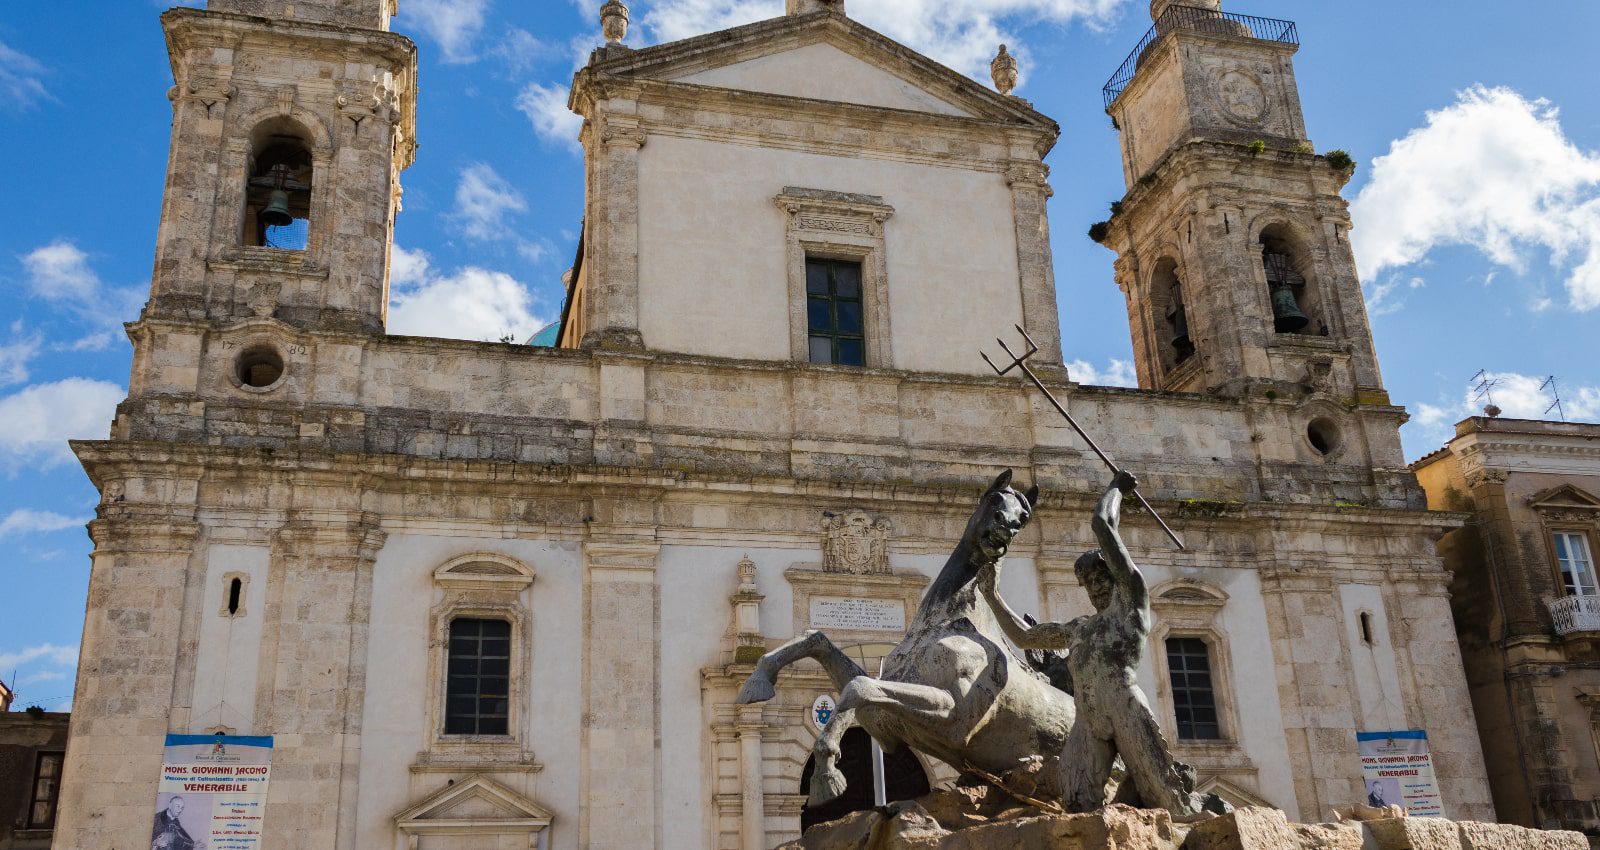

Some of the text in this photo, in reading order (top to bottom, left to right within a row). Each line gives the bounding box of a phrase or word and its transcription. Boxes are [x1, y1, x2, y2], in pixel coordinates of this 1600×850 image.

[1377, 755, 1406, 763] GIOVANNI
[164, 766, 268, 776] MONS. GIOVANNI JACONO
[1378, 769, 1419, 777] VENERABILE
[184, 783, 248, 792] VENERABILE
